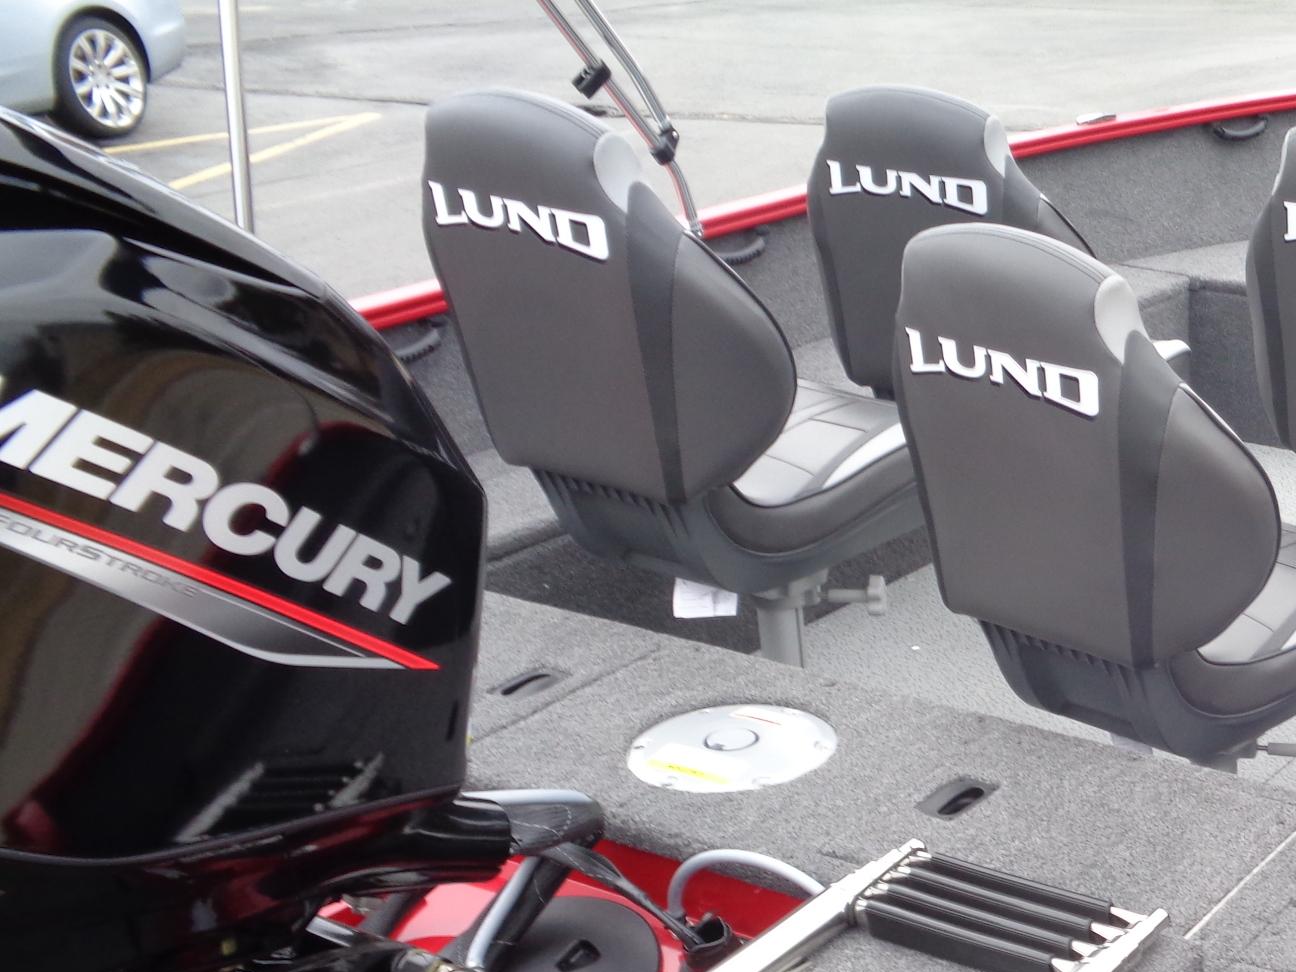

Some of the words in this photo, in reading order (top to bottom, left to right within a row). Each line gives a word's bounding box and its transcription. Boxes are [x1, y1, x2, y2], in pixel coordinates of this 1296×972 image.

[428, 180, 610, 262] LUND
[826, 158, 988, 217] LUND
[905, 326, 1100, 419] LUND
[0, 380, 452, 625] MERCURY
